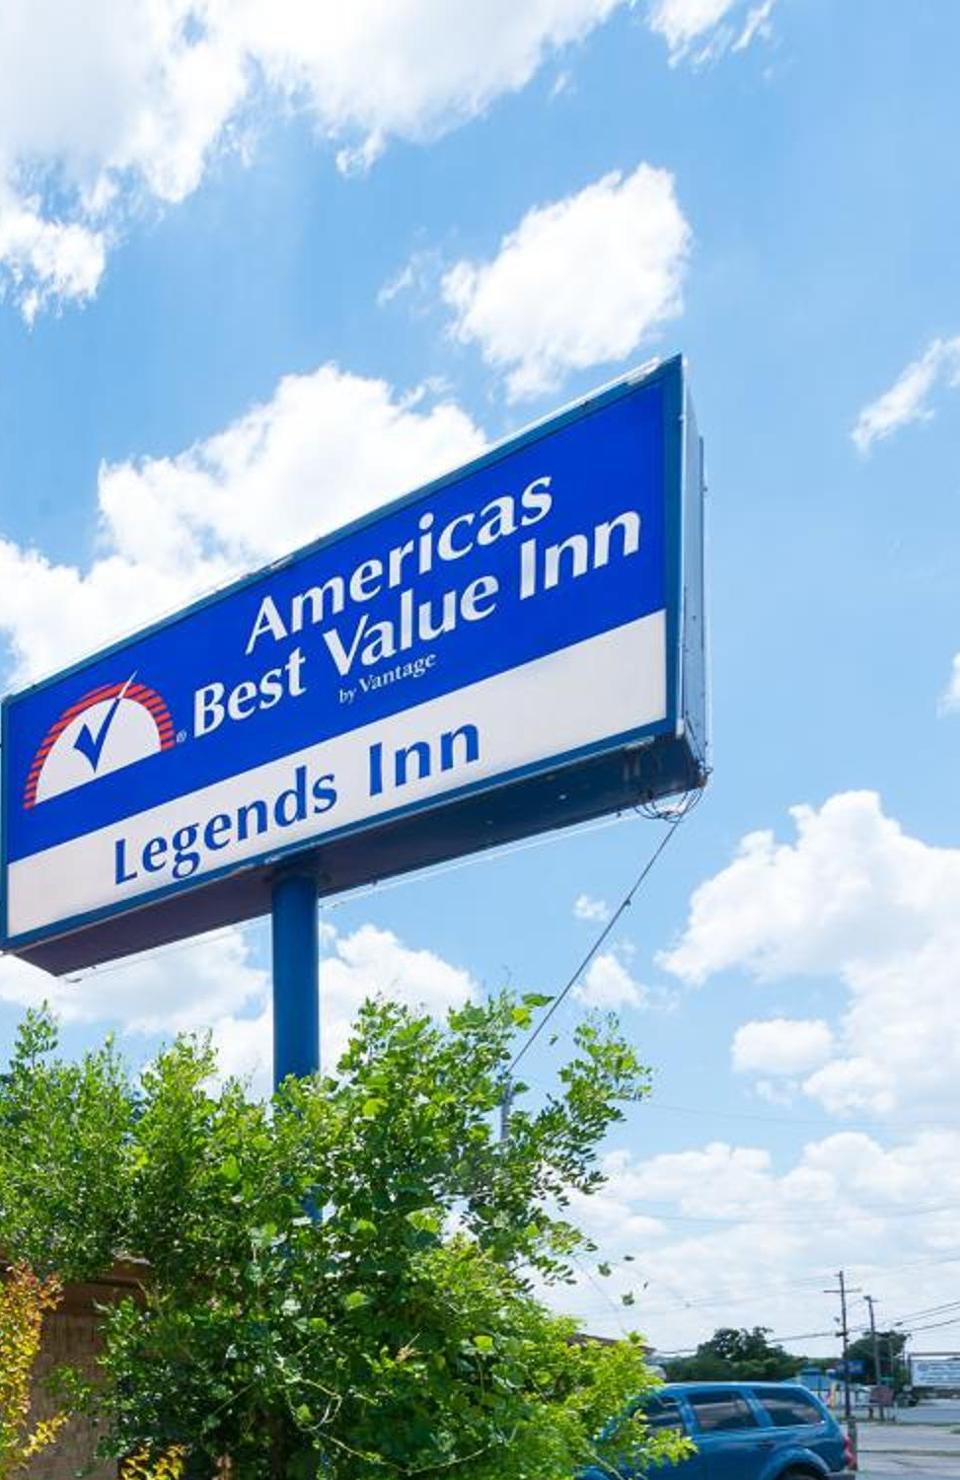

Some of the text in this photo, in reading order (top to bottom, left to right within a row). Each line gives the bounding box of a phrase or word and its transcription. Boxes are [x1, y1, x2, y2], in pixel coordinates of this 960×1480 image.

[193, 510, 641, 738] Best Value Inn
[245, 475, 553, 655] Americas
[338, 652, 438, 704] by Vantage
[114, 722, 480, 880] Legends Inn
